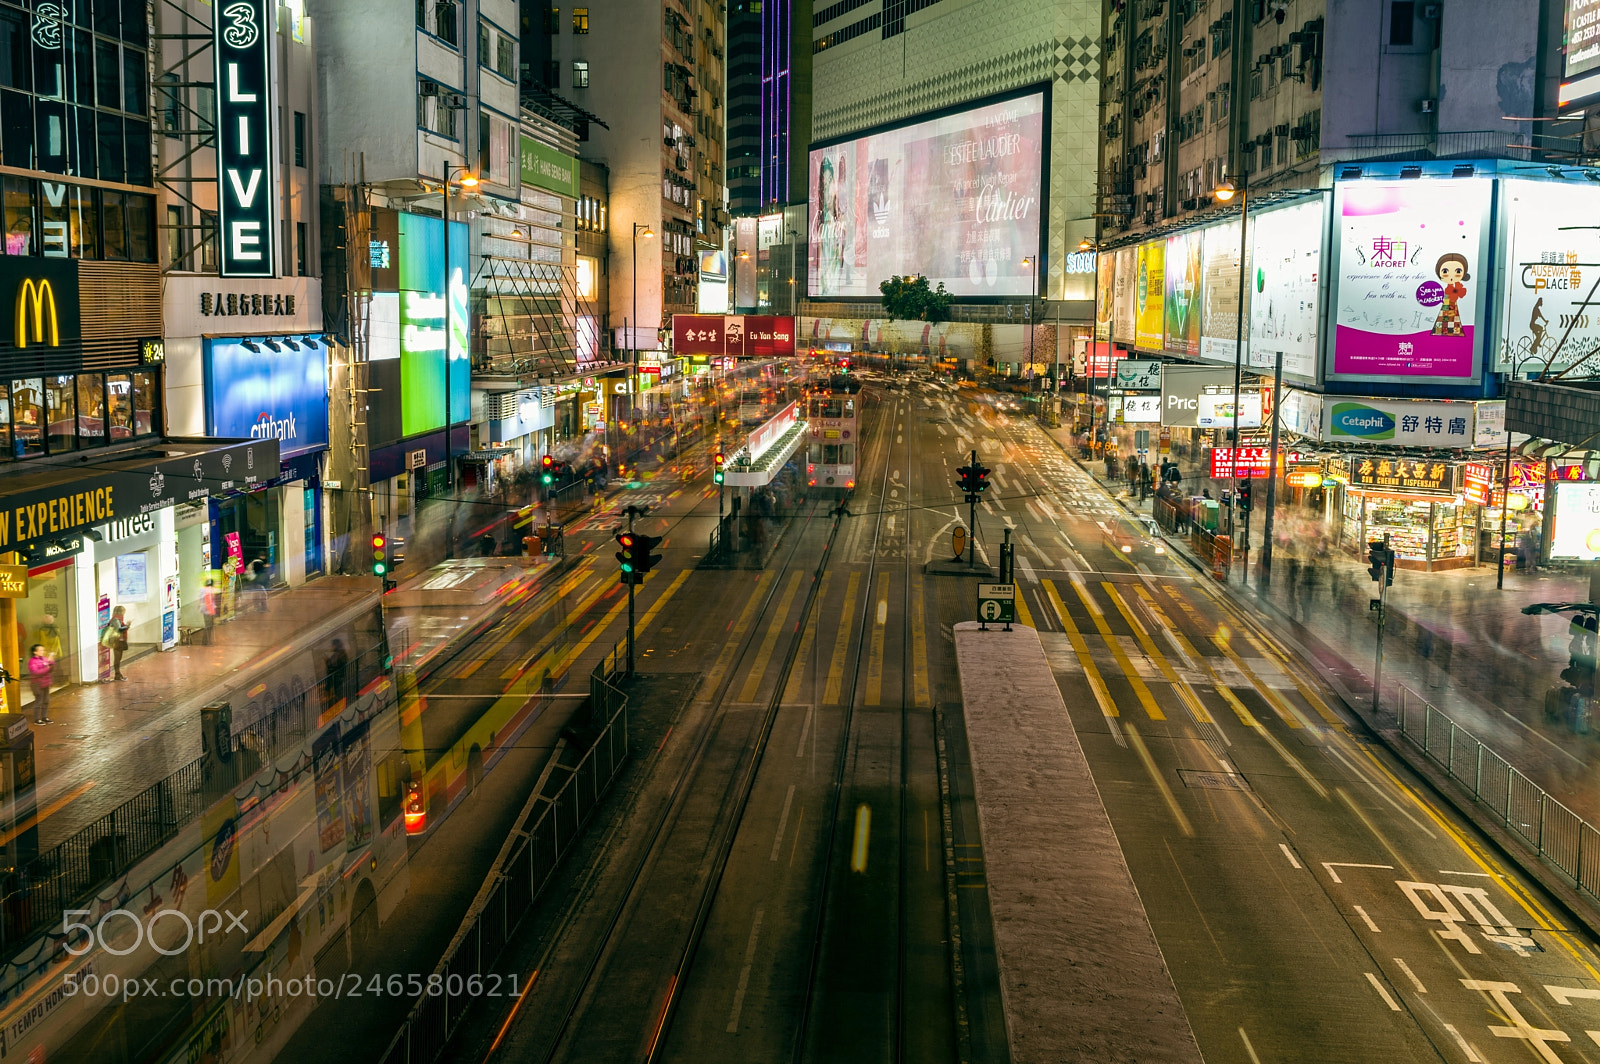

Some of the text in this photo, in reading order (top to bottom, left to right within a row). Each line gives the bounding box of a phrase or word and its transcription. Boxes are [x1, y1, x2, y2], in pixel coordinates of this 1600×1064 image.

[1576, 10, 1596, 29] CASTLE
[227, 62, 263, 260] LIVE
[976, 184, 1035, 224] Cartier
[1371, 259, 1407, 268] LAFORET
[1383, 272, 1394, 280] the
[1380, 291, 1395, 299] with
[1534, 278, 1569, 295] PLACE
[685, 328, 789, 343] 余仁生 Eu Yan Sang
[153, 344, 163, 360] 24
[1168, 395, 1198, 410] Pric
[251, 411, 297, 442] citibank
[1342, 415, 1466, 436] Cetaphil 舒特膚
[16, 486, 114, 542] EXPERIENCE
[12, 1005, 43, 1039] TEMPO
